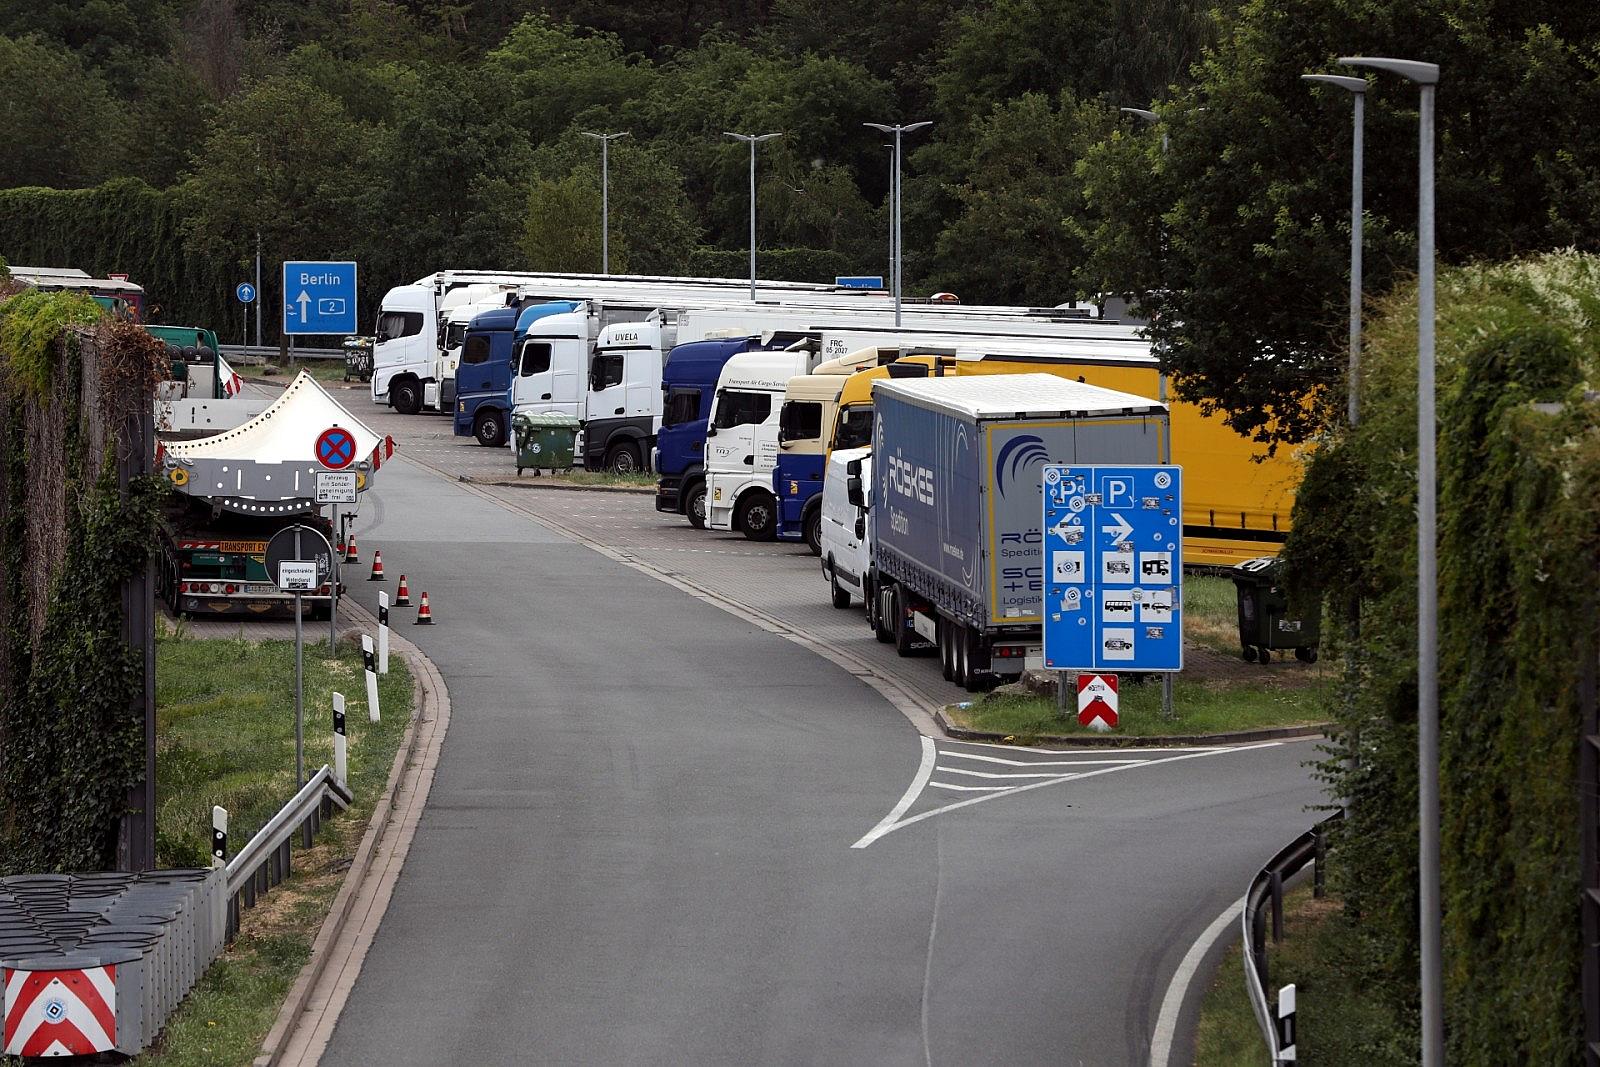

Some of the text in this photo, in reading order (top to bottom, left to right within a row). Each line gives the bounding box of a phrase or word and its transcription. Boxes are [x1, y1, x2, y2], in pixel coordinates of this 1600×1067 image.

[301, 273, 340, 285] Berlin
[329, 302, 335, 312] 2
[615, 333, 638, 341] UVELA
[728, 378, 750, 386] Transport
[889, 447, 934, 506] RÖSKES
[1061, 480, 1077, 504] P
[1110, 480, 1126, 504] P
[221, 542, 256, 551] TRANSPORT
[1001, 548, 1042, 558] Spediti
